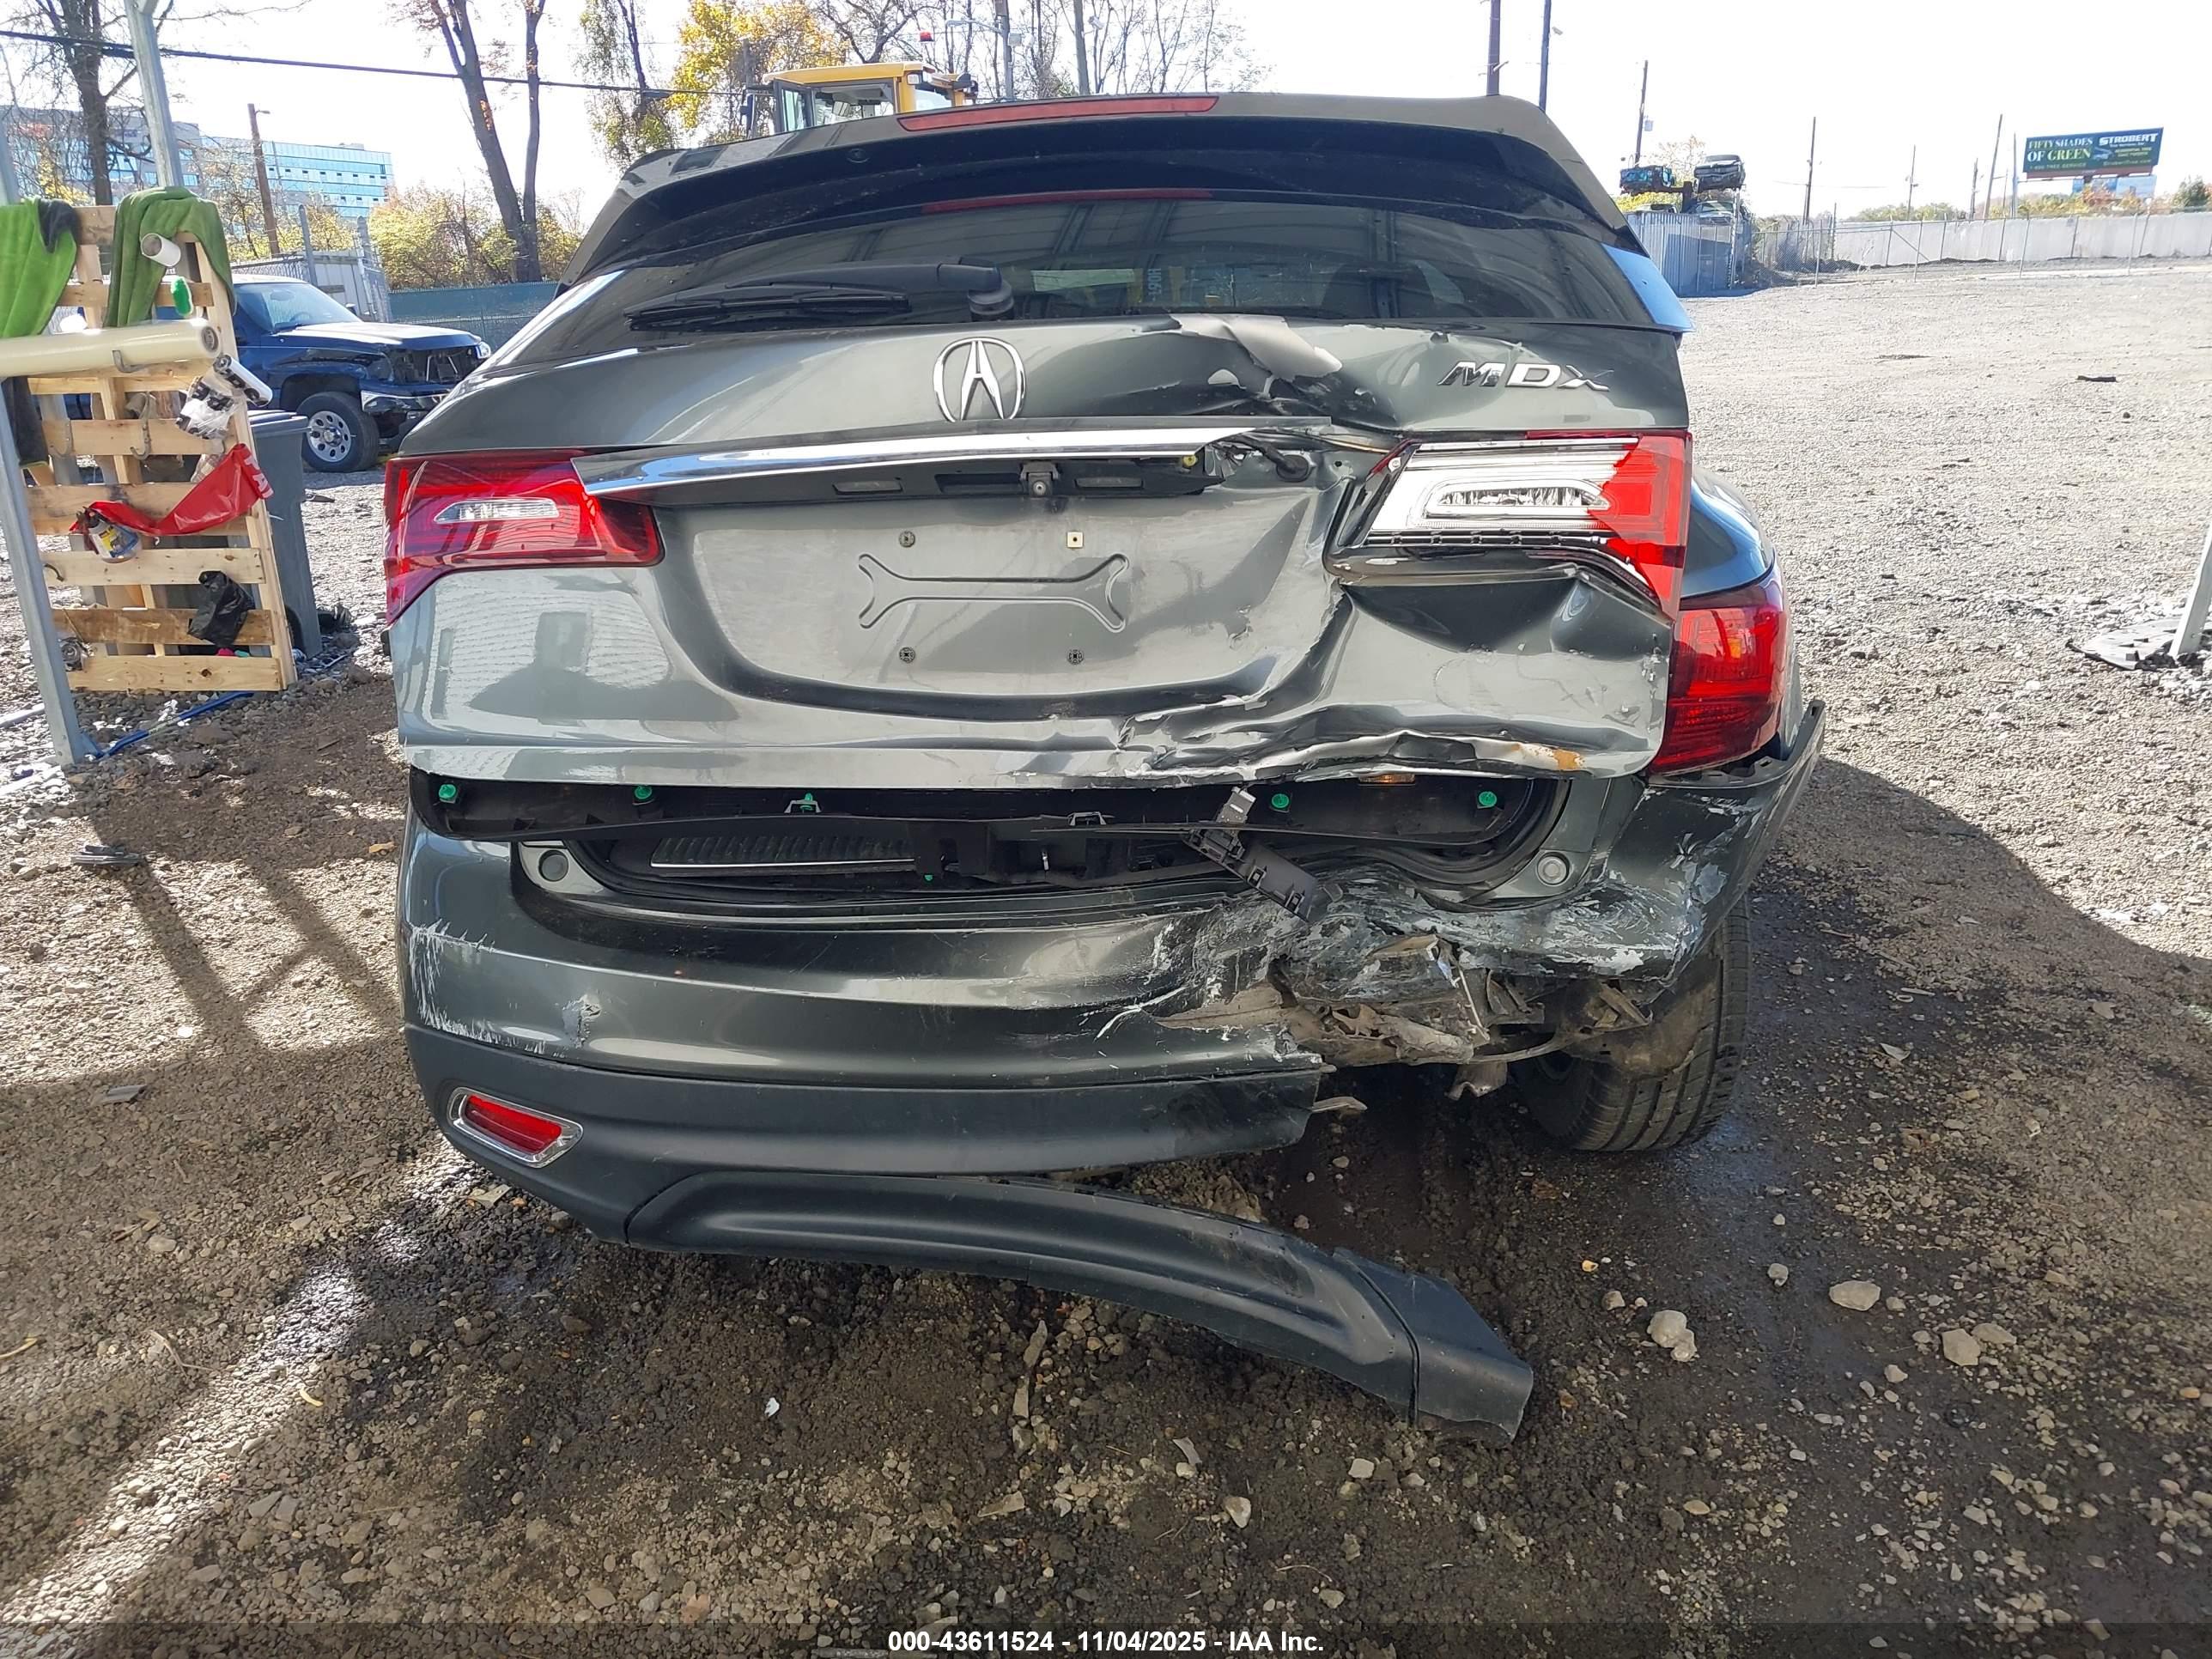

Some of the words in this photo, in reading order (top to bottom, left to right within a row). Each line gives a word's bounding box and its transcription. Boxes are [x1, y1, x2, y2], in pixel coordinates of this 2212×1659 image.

[2028, 140, 2053, 149] FIFTY
[2056, 137, 2093, 147] SHADES
[2099, 133, 2159, 146] STROBERT
[2027, 150, 2045, 161] OF
[2047, 148, 2091, 161] GREEN
[1437, 361, 1614, 392] MDX
